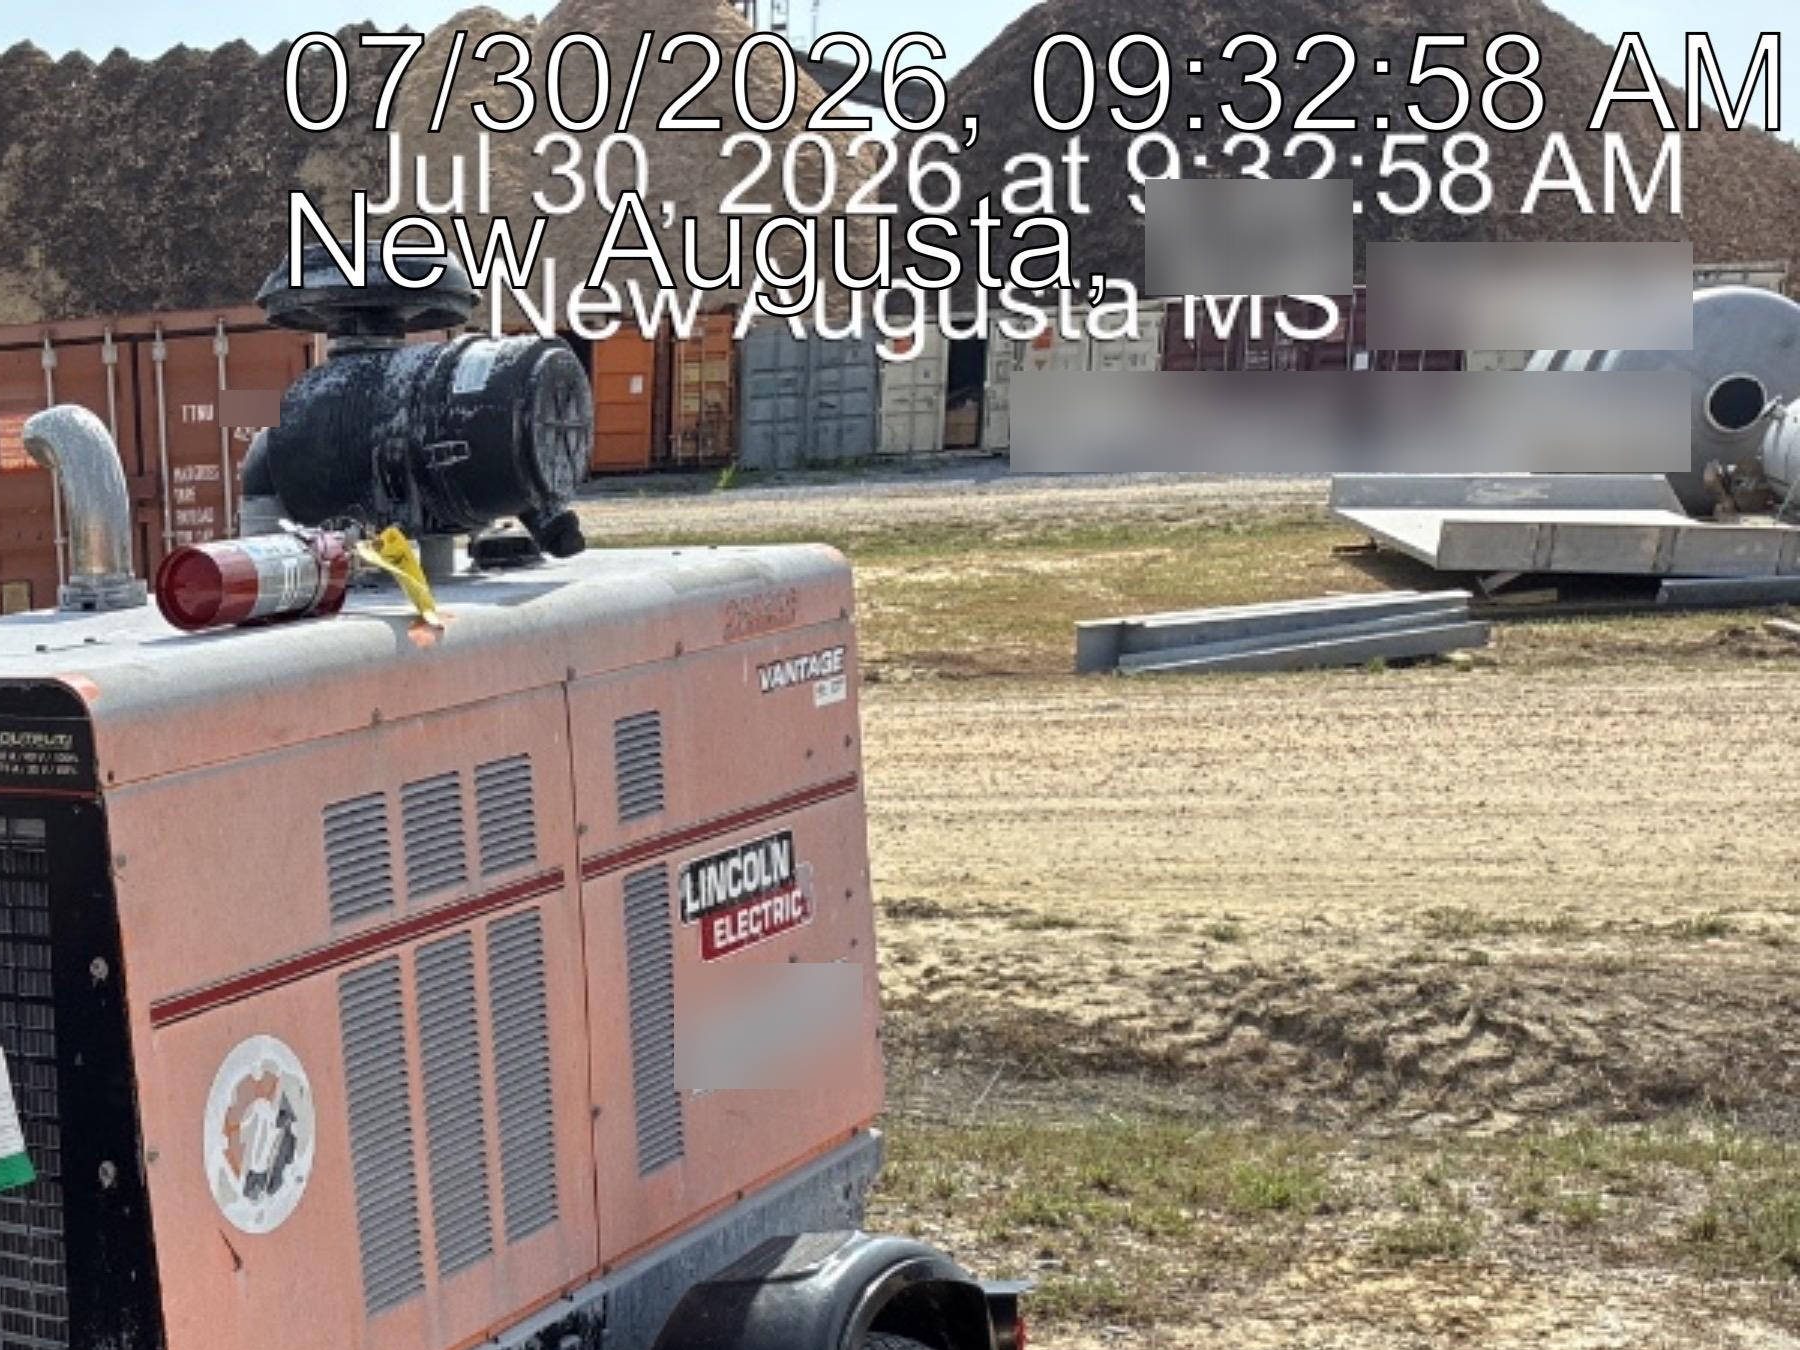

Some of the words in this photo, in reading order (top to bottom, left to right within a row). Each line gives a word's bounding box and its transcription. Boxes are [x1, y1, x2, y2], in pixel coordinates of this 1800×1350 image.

[756, 645, 846, 693] VANTAGE
[685, 838, 791, 914] LINCOLN
[712, 888, 802, 949] ELECTRIC
